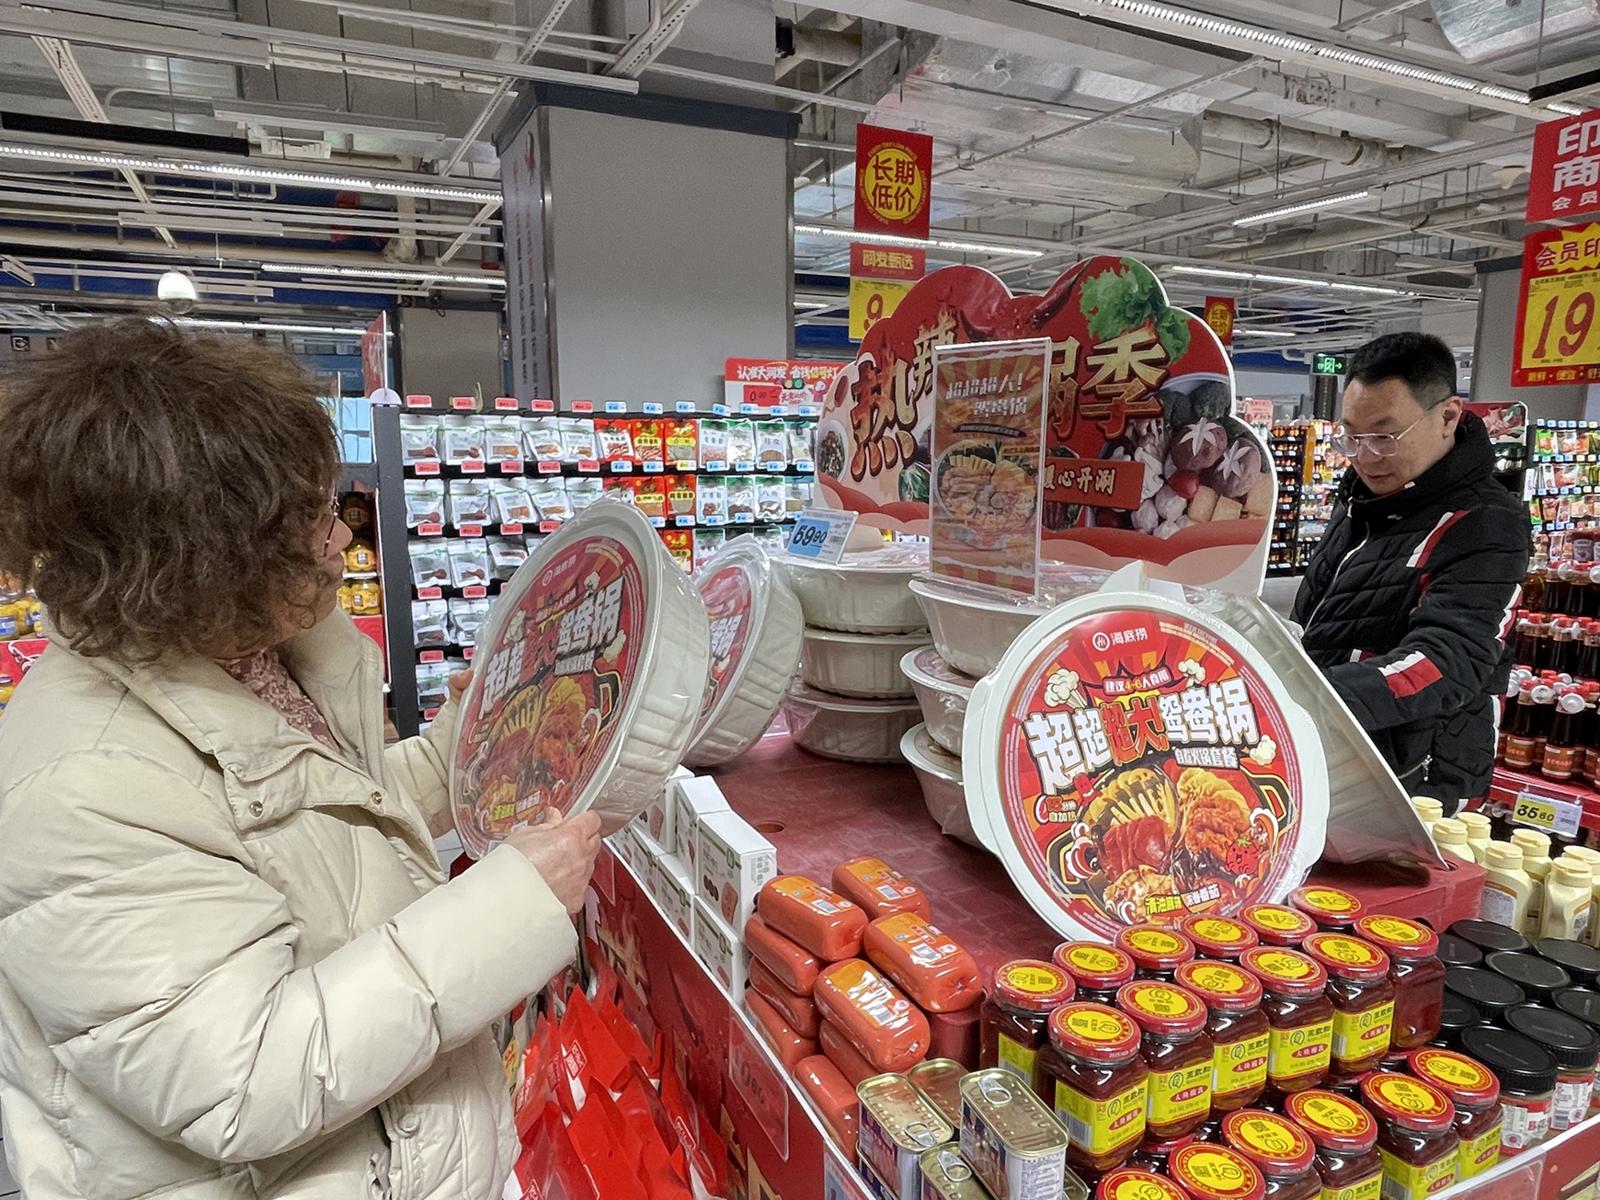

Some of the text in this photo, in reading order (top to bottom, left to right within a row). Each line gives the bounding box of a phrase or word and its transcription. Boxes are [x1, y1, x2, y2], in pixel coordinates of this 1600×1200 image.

[873, 154, 915, 185] 长期
[872, 183, 915, 213] 低价
[1552, 191, 1598, 211] 会员
[1532, 291, 1596, 359] 19
[1111, 627, 1148, 646] 海底捞
[1105, 668, 1170, 693] 建议4-6人食用
